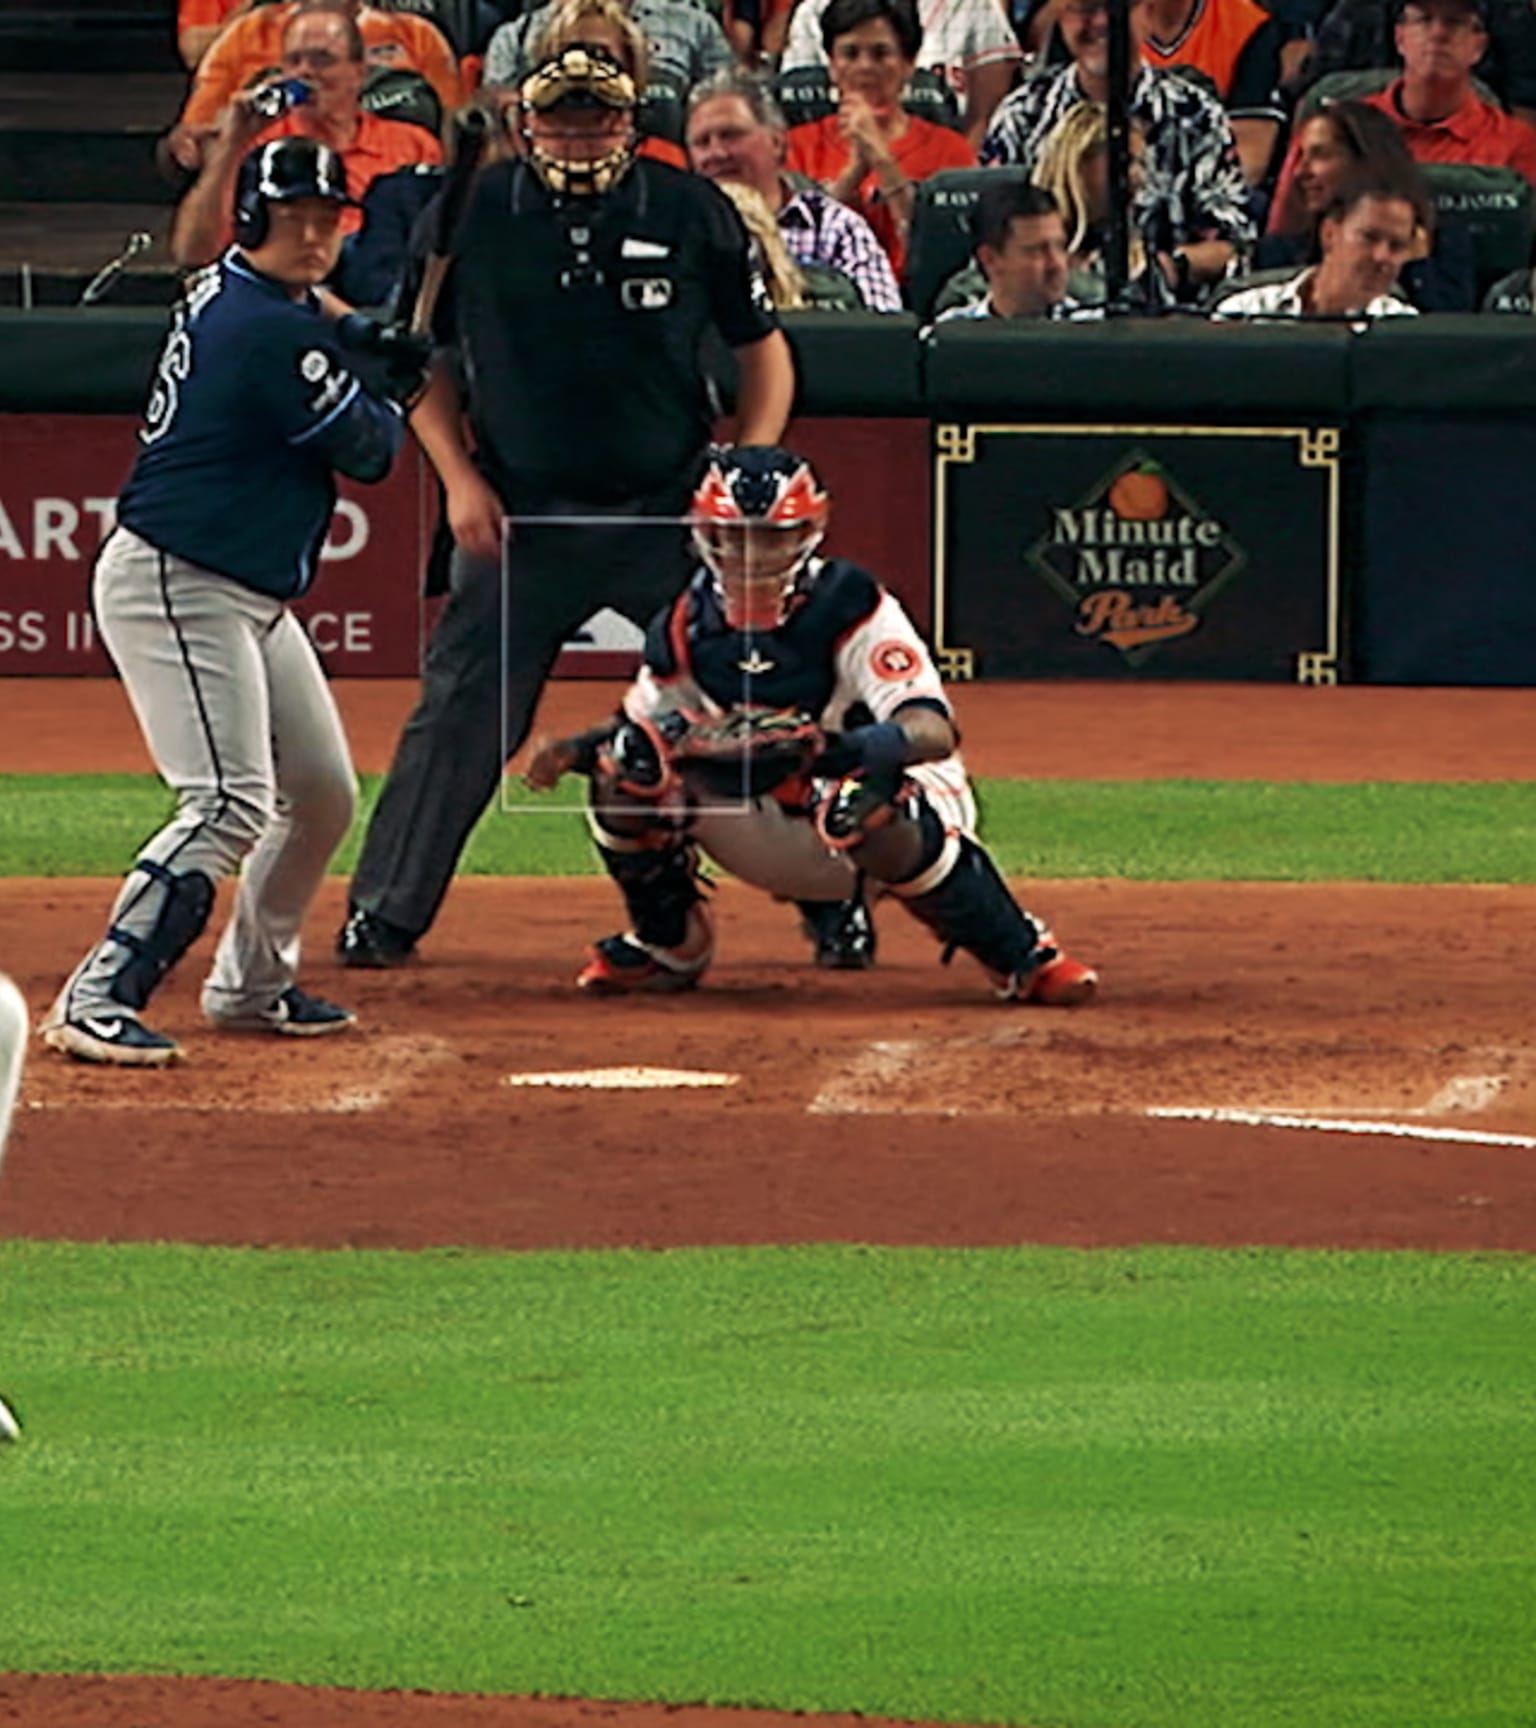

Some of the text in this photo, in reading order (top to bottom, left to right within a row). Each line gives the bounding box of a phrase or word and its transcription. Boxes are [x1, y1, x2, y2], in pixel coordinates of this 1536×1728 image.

[1052, 508, 1222, 546] Minute
[1076, 548, 1199, 585] Maid
[1074, 591, 1194, 640] Park
